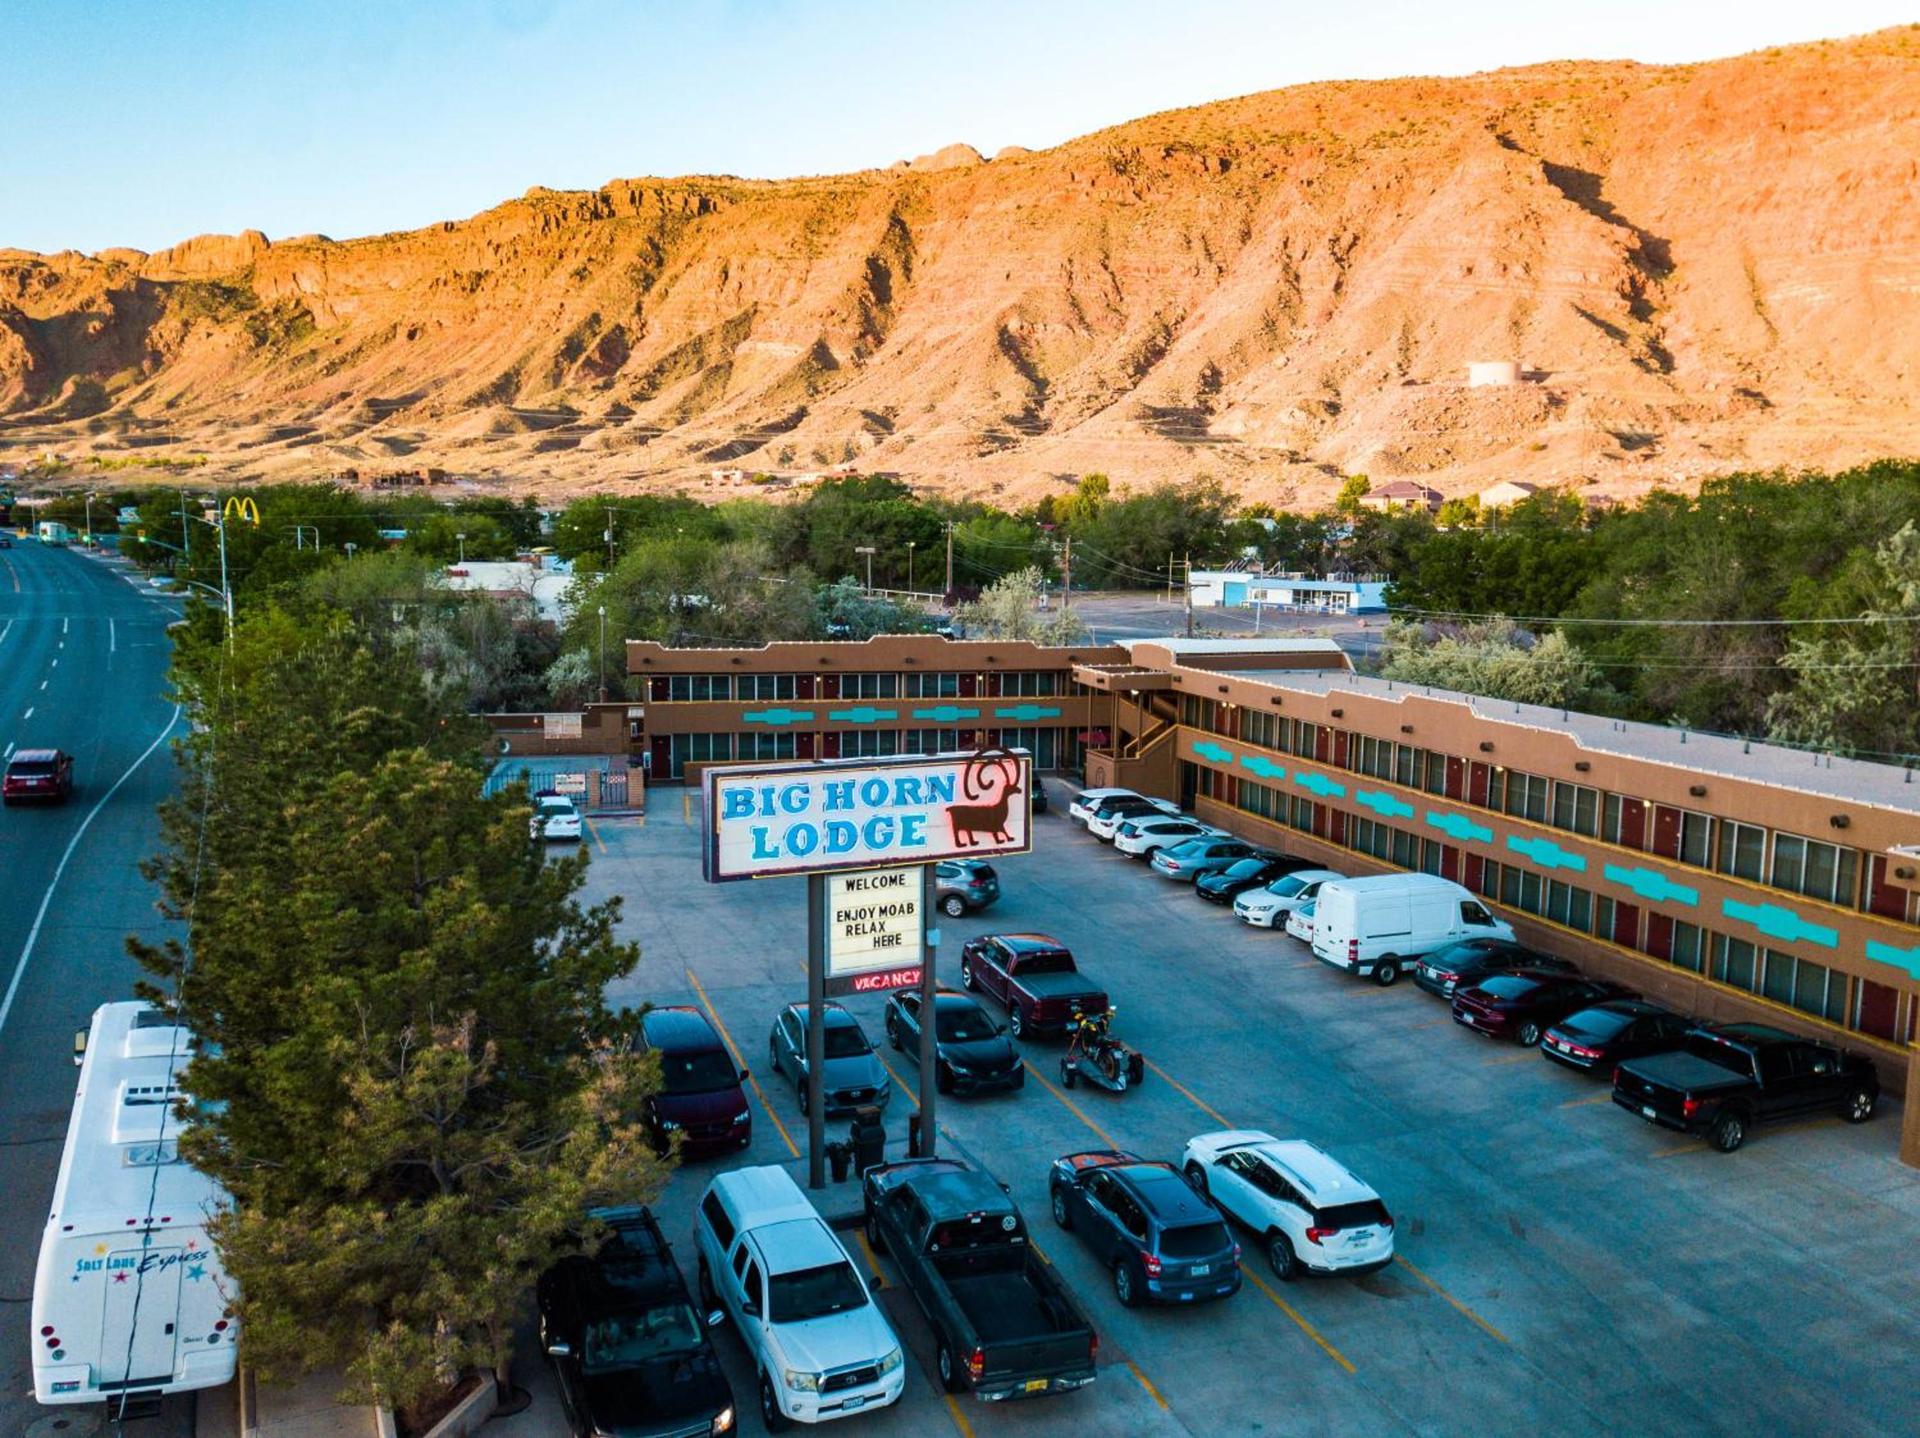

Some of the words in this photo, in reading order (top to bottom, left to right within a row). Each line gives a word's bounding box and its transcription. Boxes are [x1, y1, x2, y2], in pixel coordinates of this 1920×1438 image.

[723, 784, 810, 820] BIG
[824, 774, 956, 811] HORN
[750, 814, 927, 860] LODGE
[845, 874, 906, 892] WELCOME
[836, 908, 875, 923] ENJOY
[879, 903, 914, 918] MOAB
[845, 920, 886, 937] RELAX
[873, 934, 902, 949] HERE
[855, 971, 921, 990] VACANCY
